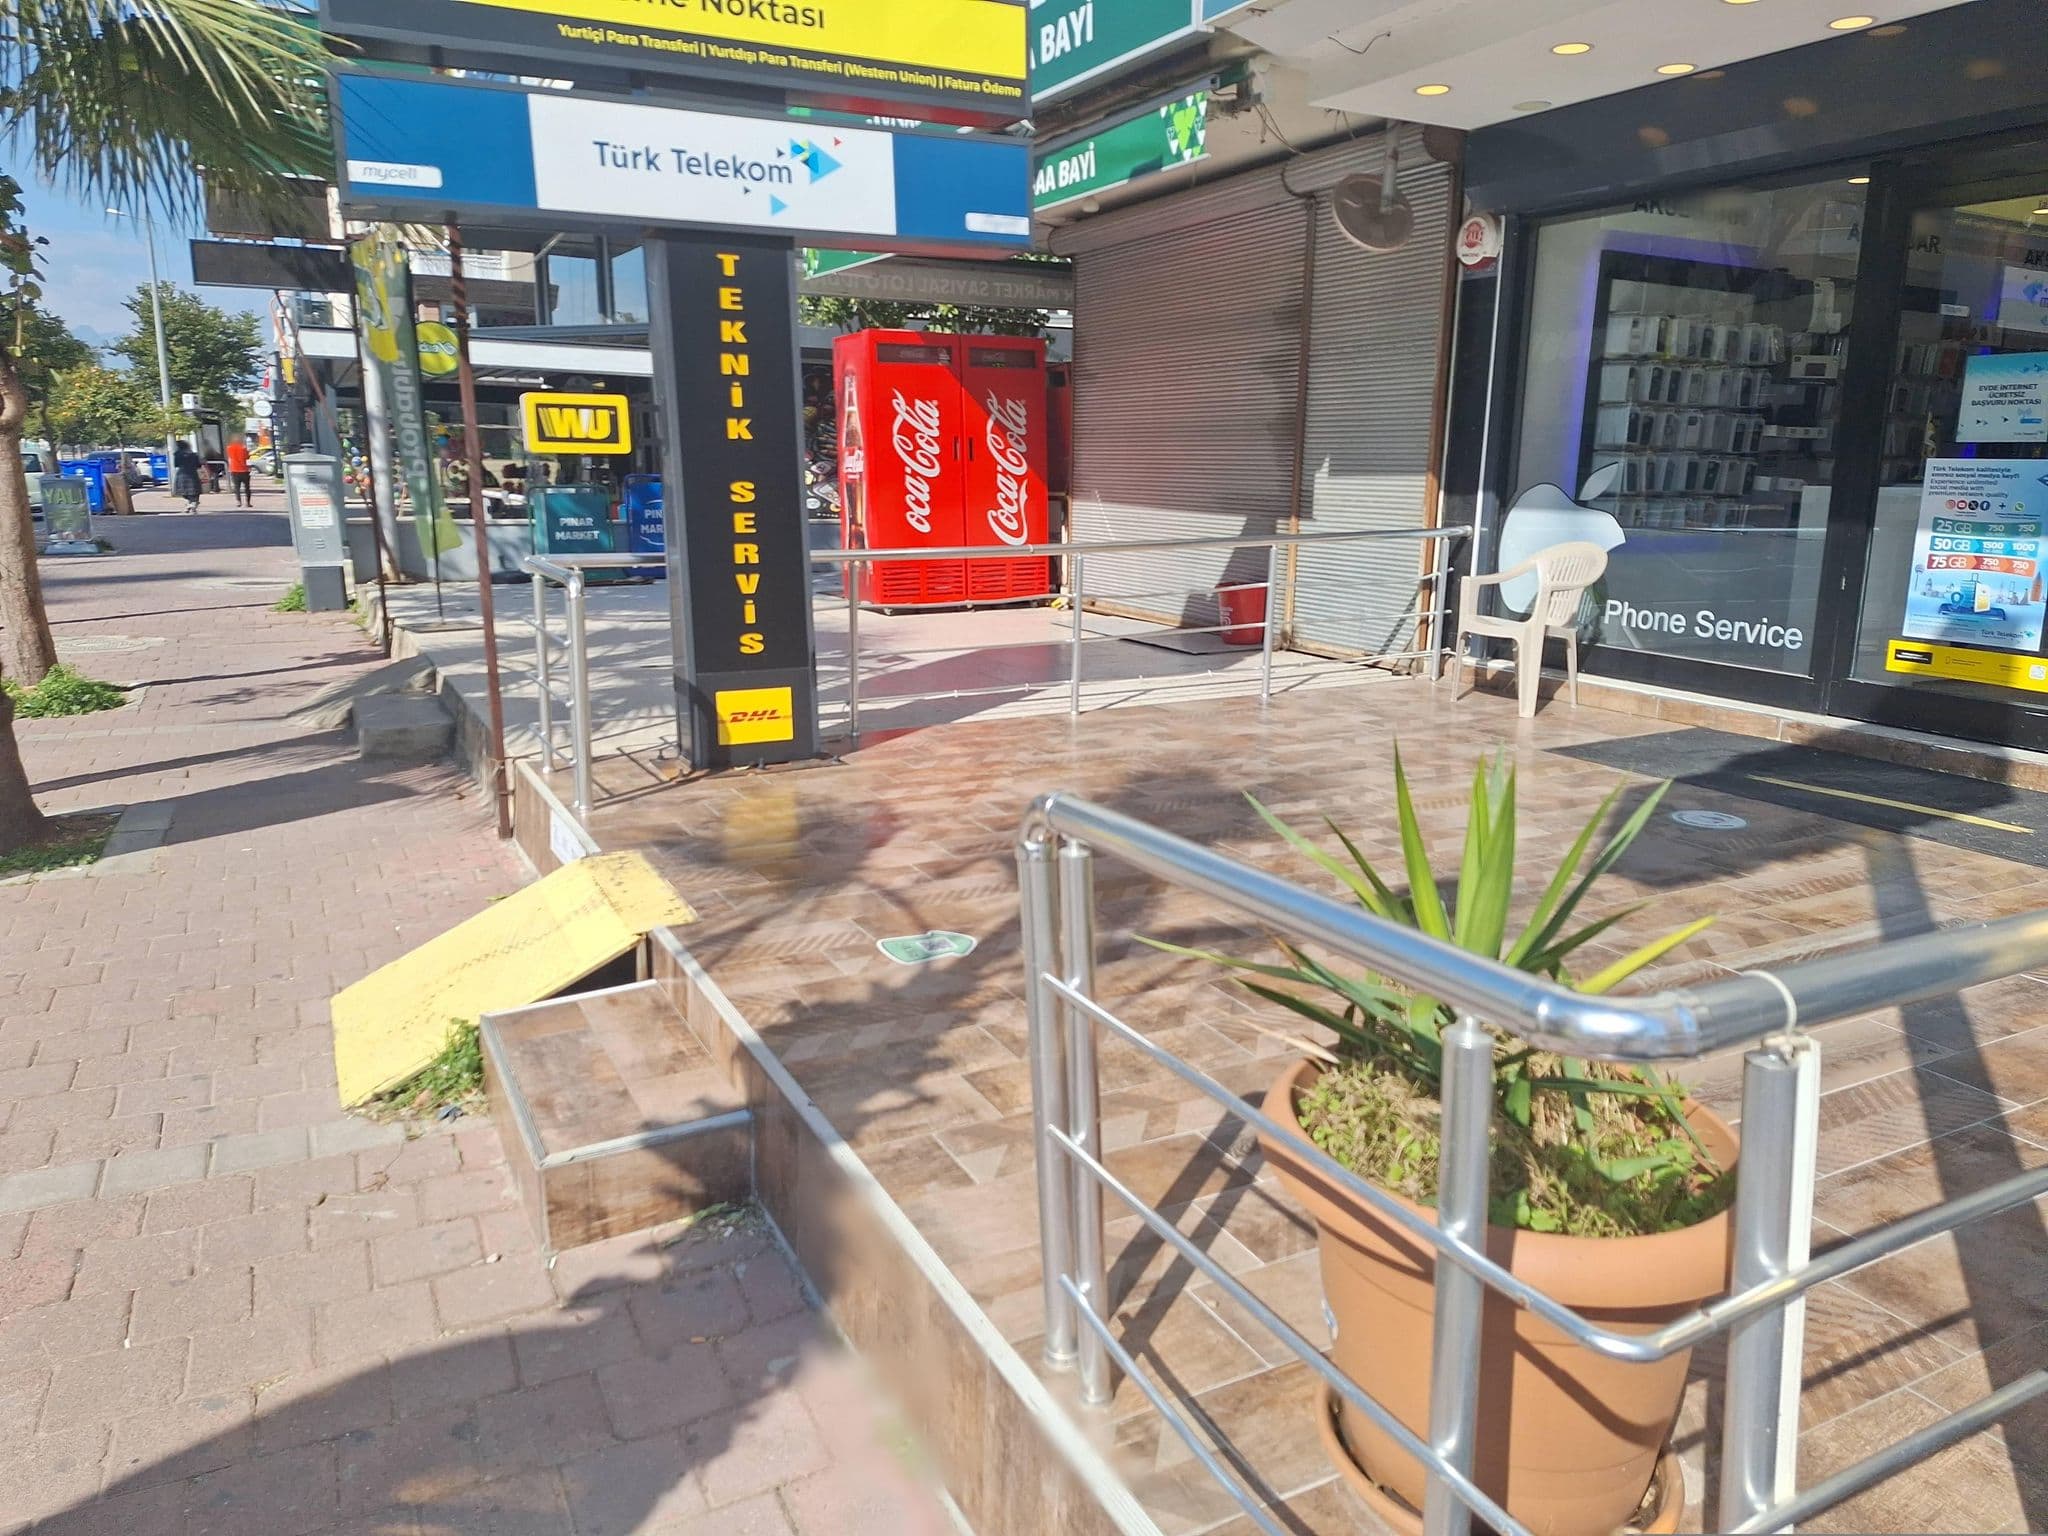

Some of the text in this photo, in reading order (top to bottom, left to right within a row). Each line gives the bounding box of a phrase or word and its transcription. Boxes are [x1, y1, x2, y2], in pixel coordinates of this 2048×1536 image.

[1040, 0, 1094, 65] BAYİ
[557, 23, 604, 44] Yurtiçi
[606, 30, 639, 47] Para
[641, 34, 700, 55] Transferi
[709, 43, 756, 64] Yurtdışı
[759, 50, 788, 67] Para
[790, 54, 842, 75] Transferi
[844, 62, 897, 82] (Western
[899, 69, 937, 88] Union)
[944, 75, 981, 93] Fatura
[982, 79, 1022, 98] Ödeme
[592, 140, 793, 184] Türk Telekom
[1033, 141, 1096, 196] AA BAYİ
[362, 164, 417, 180] mycell
[715, 252, 754, 441] TEKNİK
[1978, 383, 2040, 392] EVDE İNTERNET
[2007, 398, 2042, 406] NOKTASI
[538, 407, 612, 440] WU
[644, 509, 664, 519] PIN
[640, 524, 664, 534] MAR
[1936, 520, 1952, 532] 25
[1954, 522, 1972, 534] GB
[1933, 537, 1952, 550] 50
[1953, 539, 1971, 551] GB
[2012, 542, 2036, 551] 1000
[729, 480, 765, 655] SERVİS
[1931, 556, 2030, 569] 75 GB 750 750
[1603, 599, 1803, 650] Phone Service
[729, 708, 781, 723] DHL
